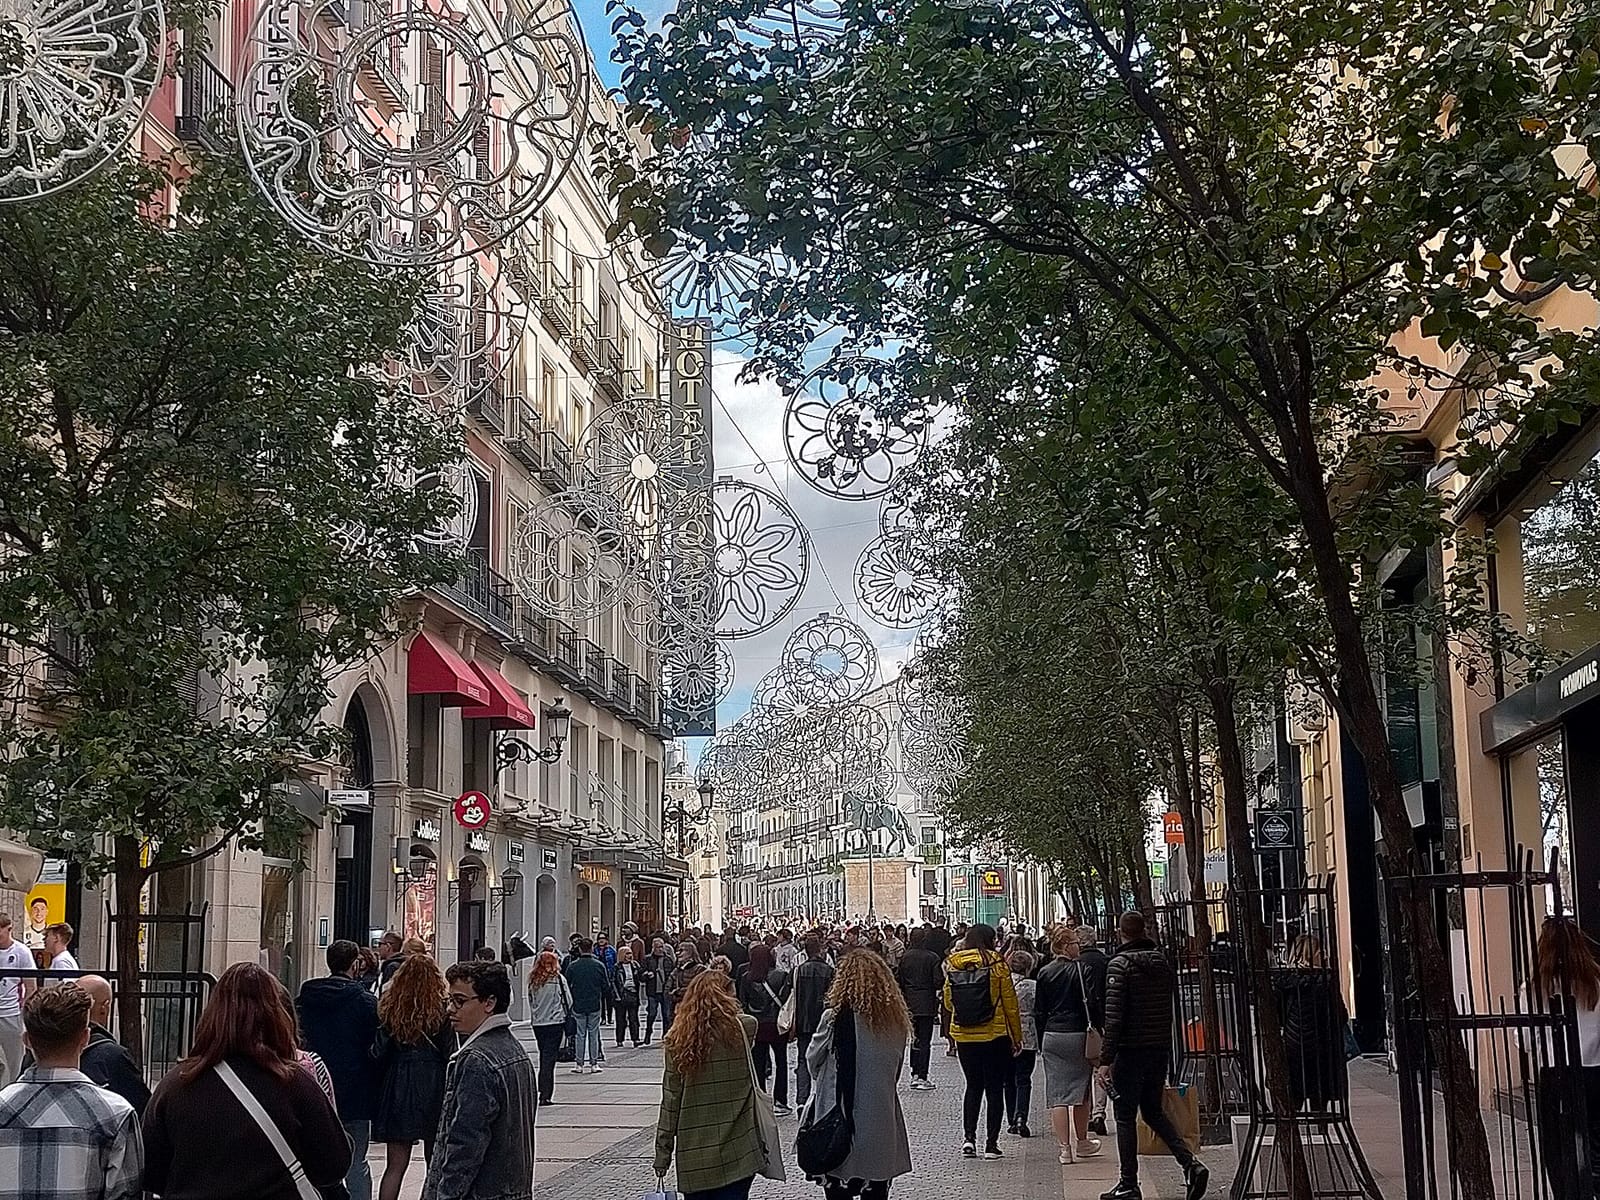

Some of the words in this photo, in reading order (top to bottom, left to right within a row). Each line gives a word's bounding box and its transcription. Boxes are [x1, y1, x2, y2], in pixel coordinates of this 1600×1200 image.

[676, 324, 706, 466] HOTEL
[1166, 819, 1184, 833] ria
[1205, 855, 1225, 863] adrid
